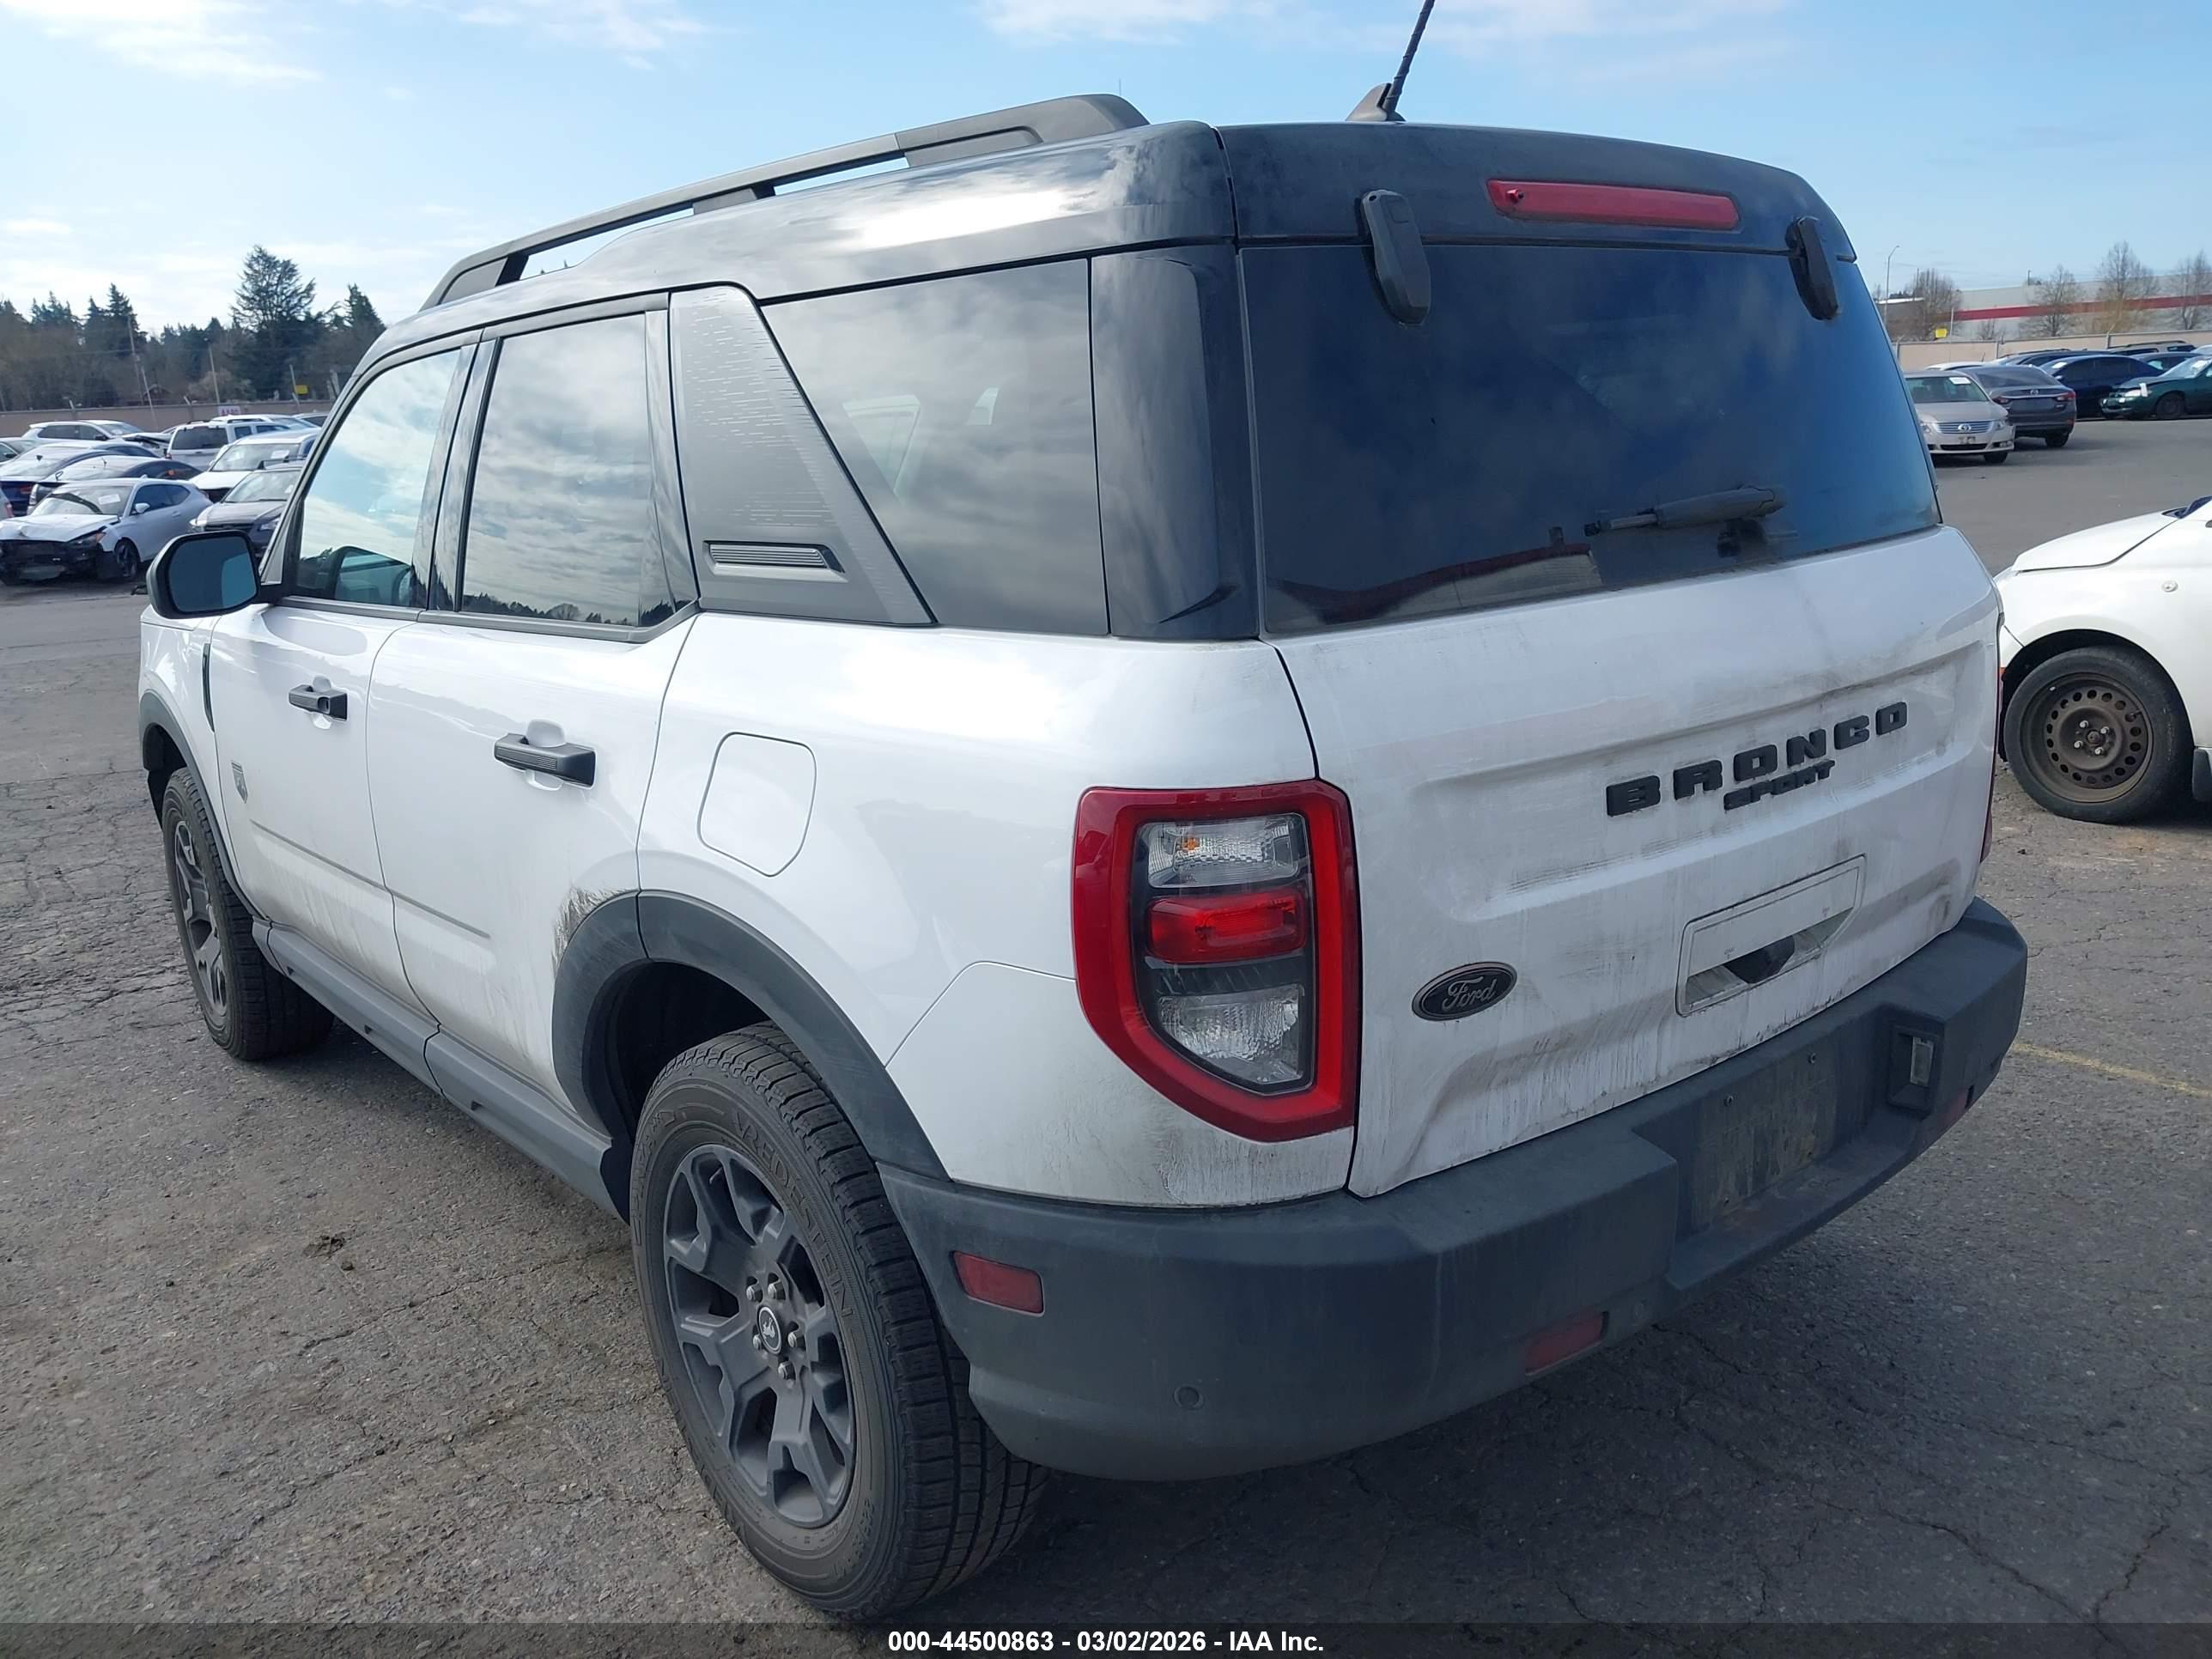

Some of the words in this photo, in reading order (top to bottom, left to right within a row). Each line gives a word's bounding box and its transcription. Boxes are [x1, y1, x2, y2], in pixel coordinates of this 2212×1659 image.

[1606, 701, 1908, 817] BRONCO
[1723, 759, 1836, 811] SPORT
[1441, 975, 1498, 1011] Ford
